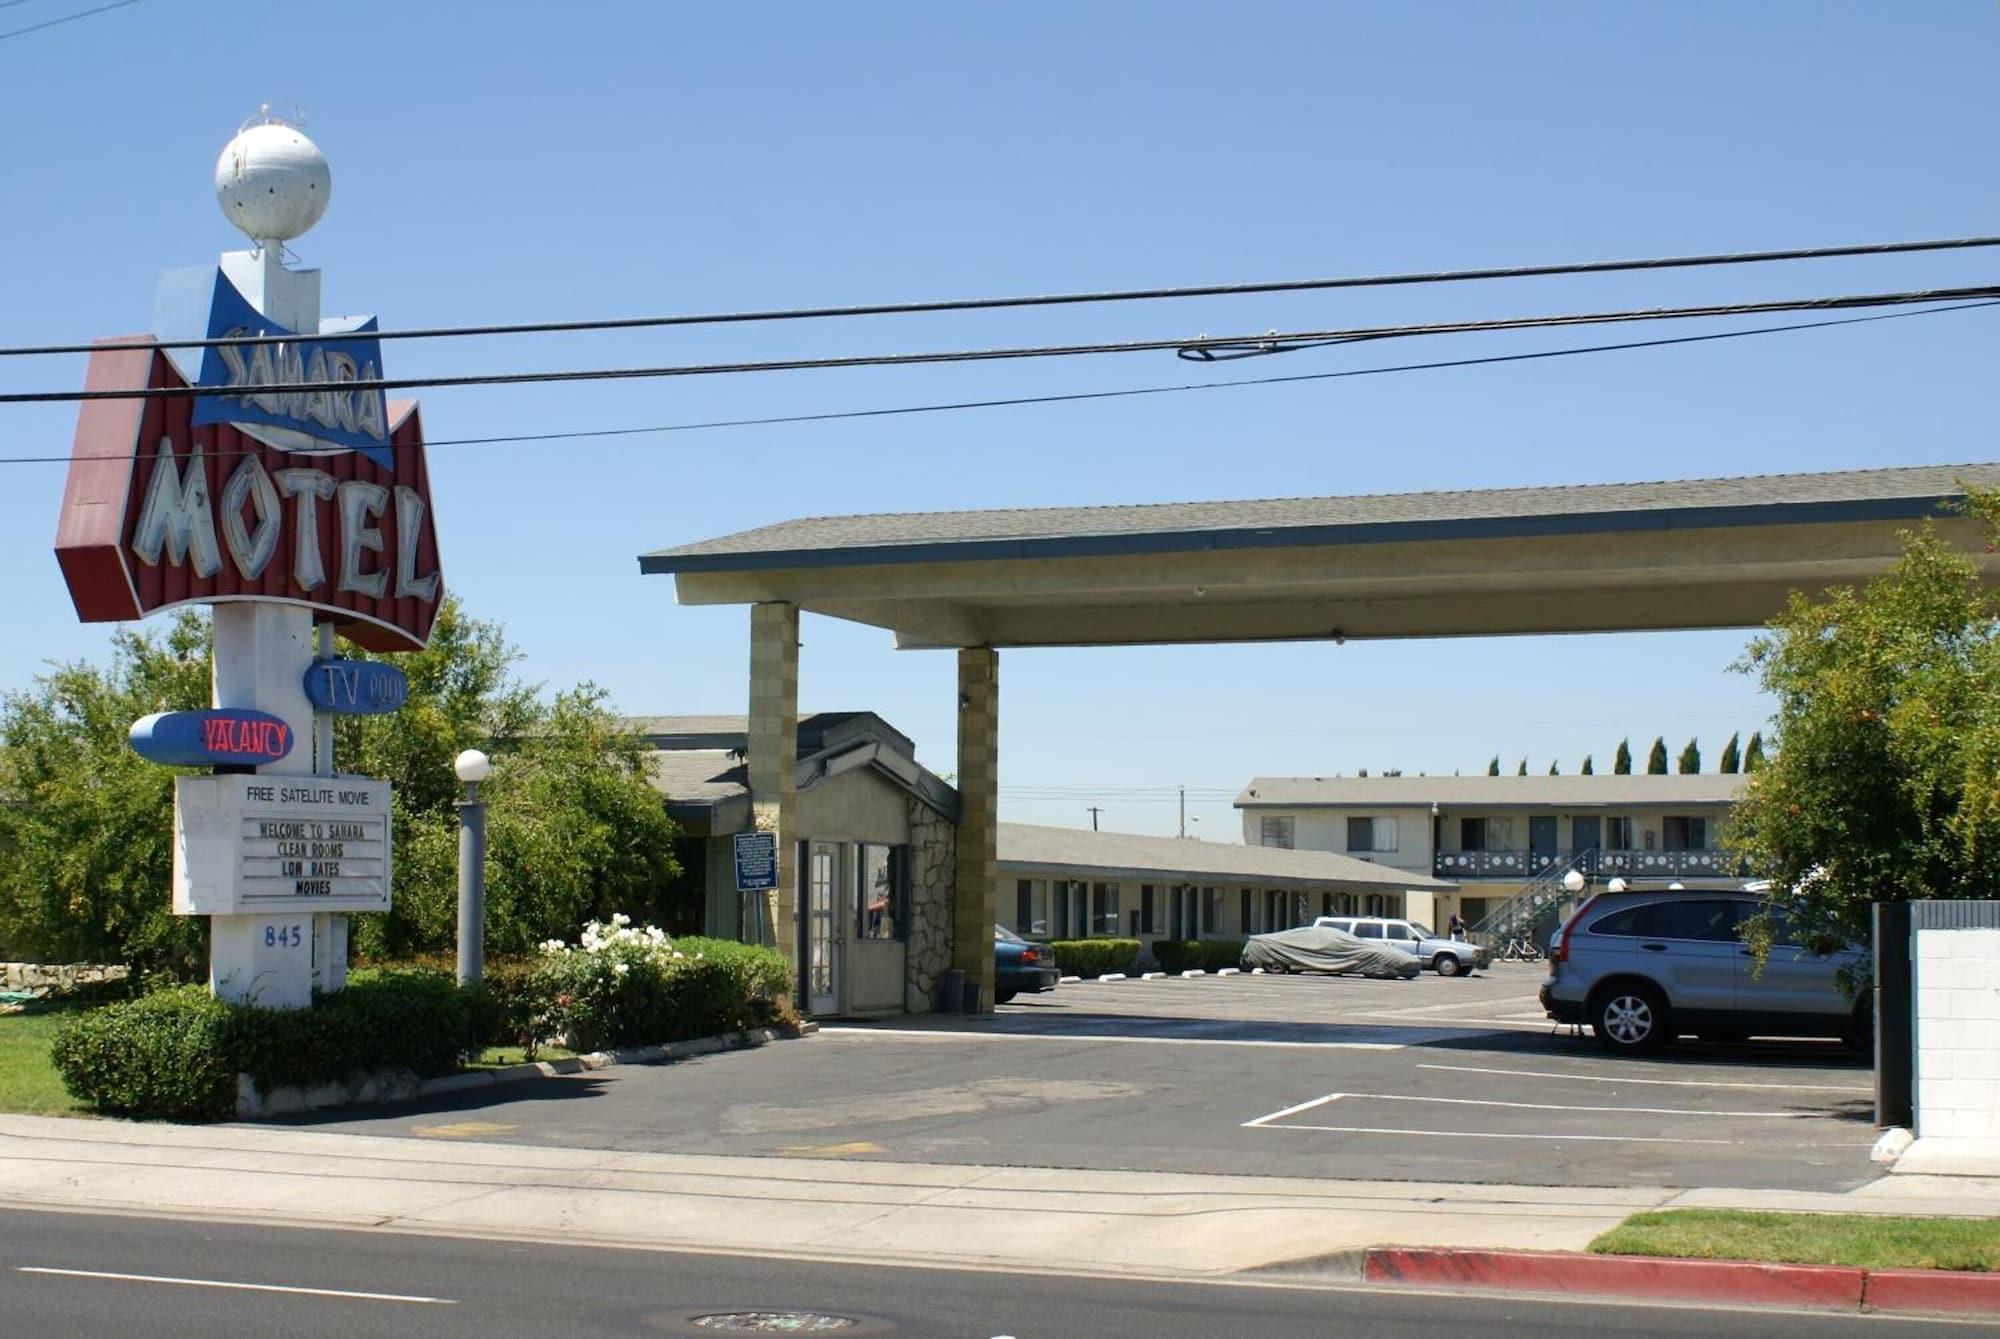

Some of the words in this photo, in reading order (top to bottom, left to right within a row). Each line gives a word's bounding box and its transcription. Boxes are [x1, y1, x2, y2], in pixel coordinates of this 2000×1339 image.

[217, 326, 385, 441] SAHARA
[132, 436, 440, 602] MOTEL
[321, 665, 359, 706] TV
[204, 719, 287, 756] VACANCY
[247, 786, 274, 801] FREE
[280, 788, 334, 804] SATELLITE
[338, 791, 369, 806] MOVIE
[260, 823, 305, 839] WELCOME
[310, 824, 323, 839] TO
[329, 825, 364, 840] SAHARA
[277, 842, 307, 857] CLEAN
[311, 843, 344, 857] ROOMS
[282, 861, 303, 876] LOW
[310, 861, 340, 876] RATES
[295, 880, 331, 895] MOVIES
[265, 925, 301, 947] 845
